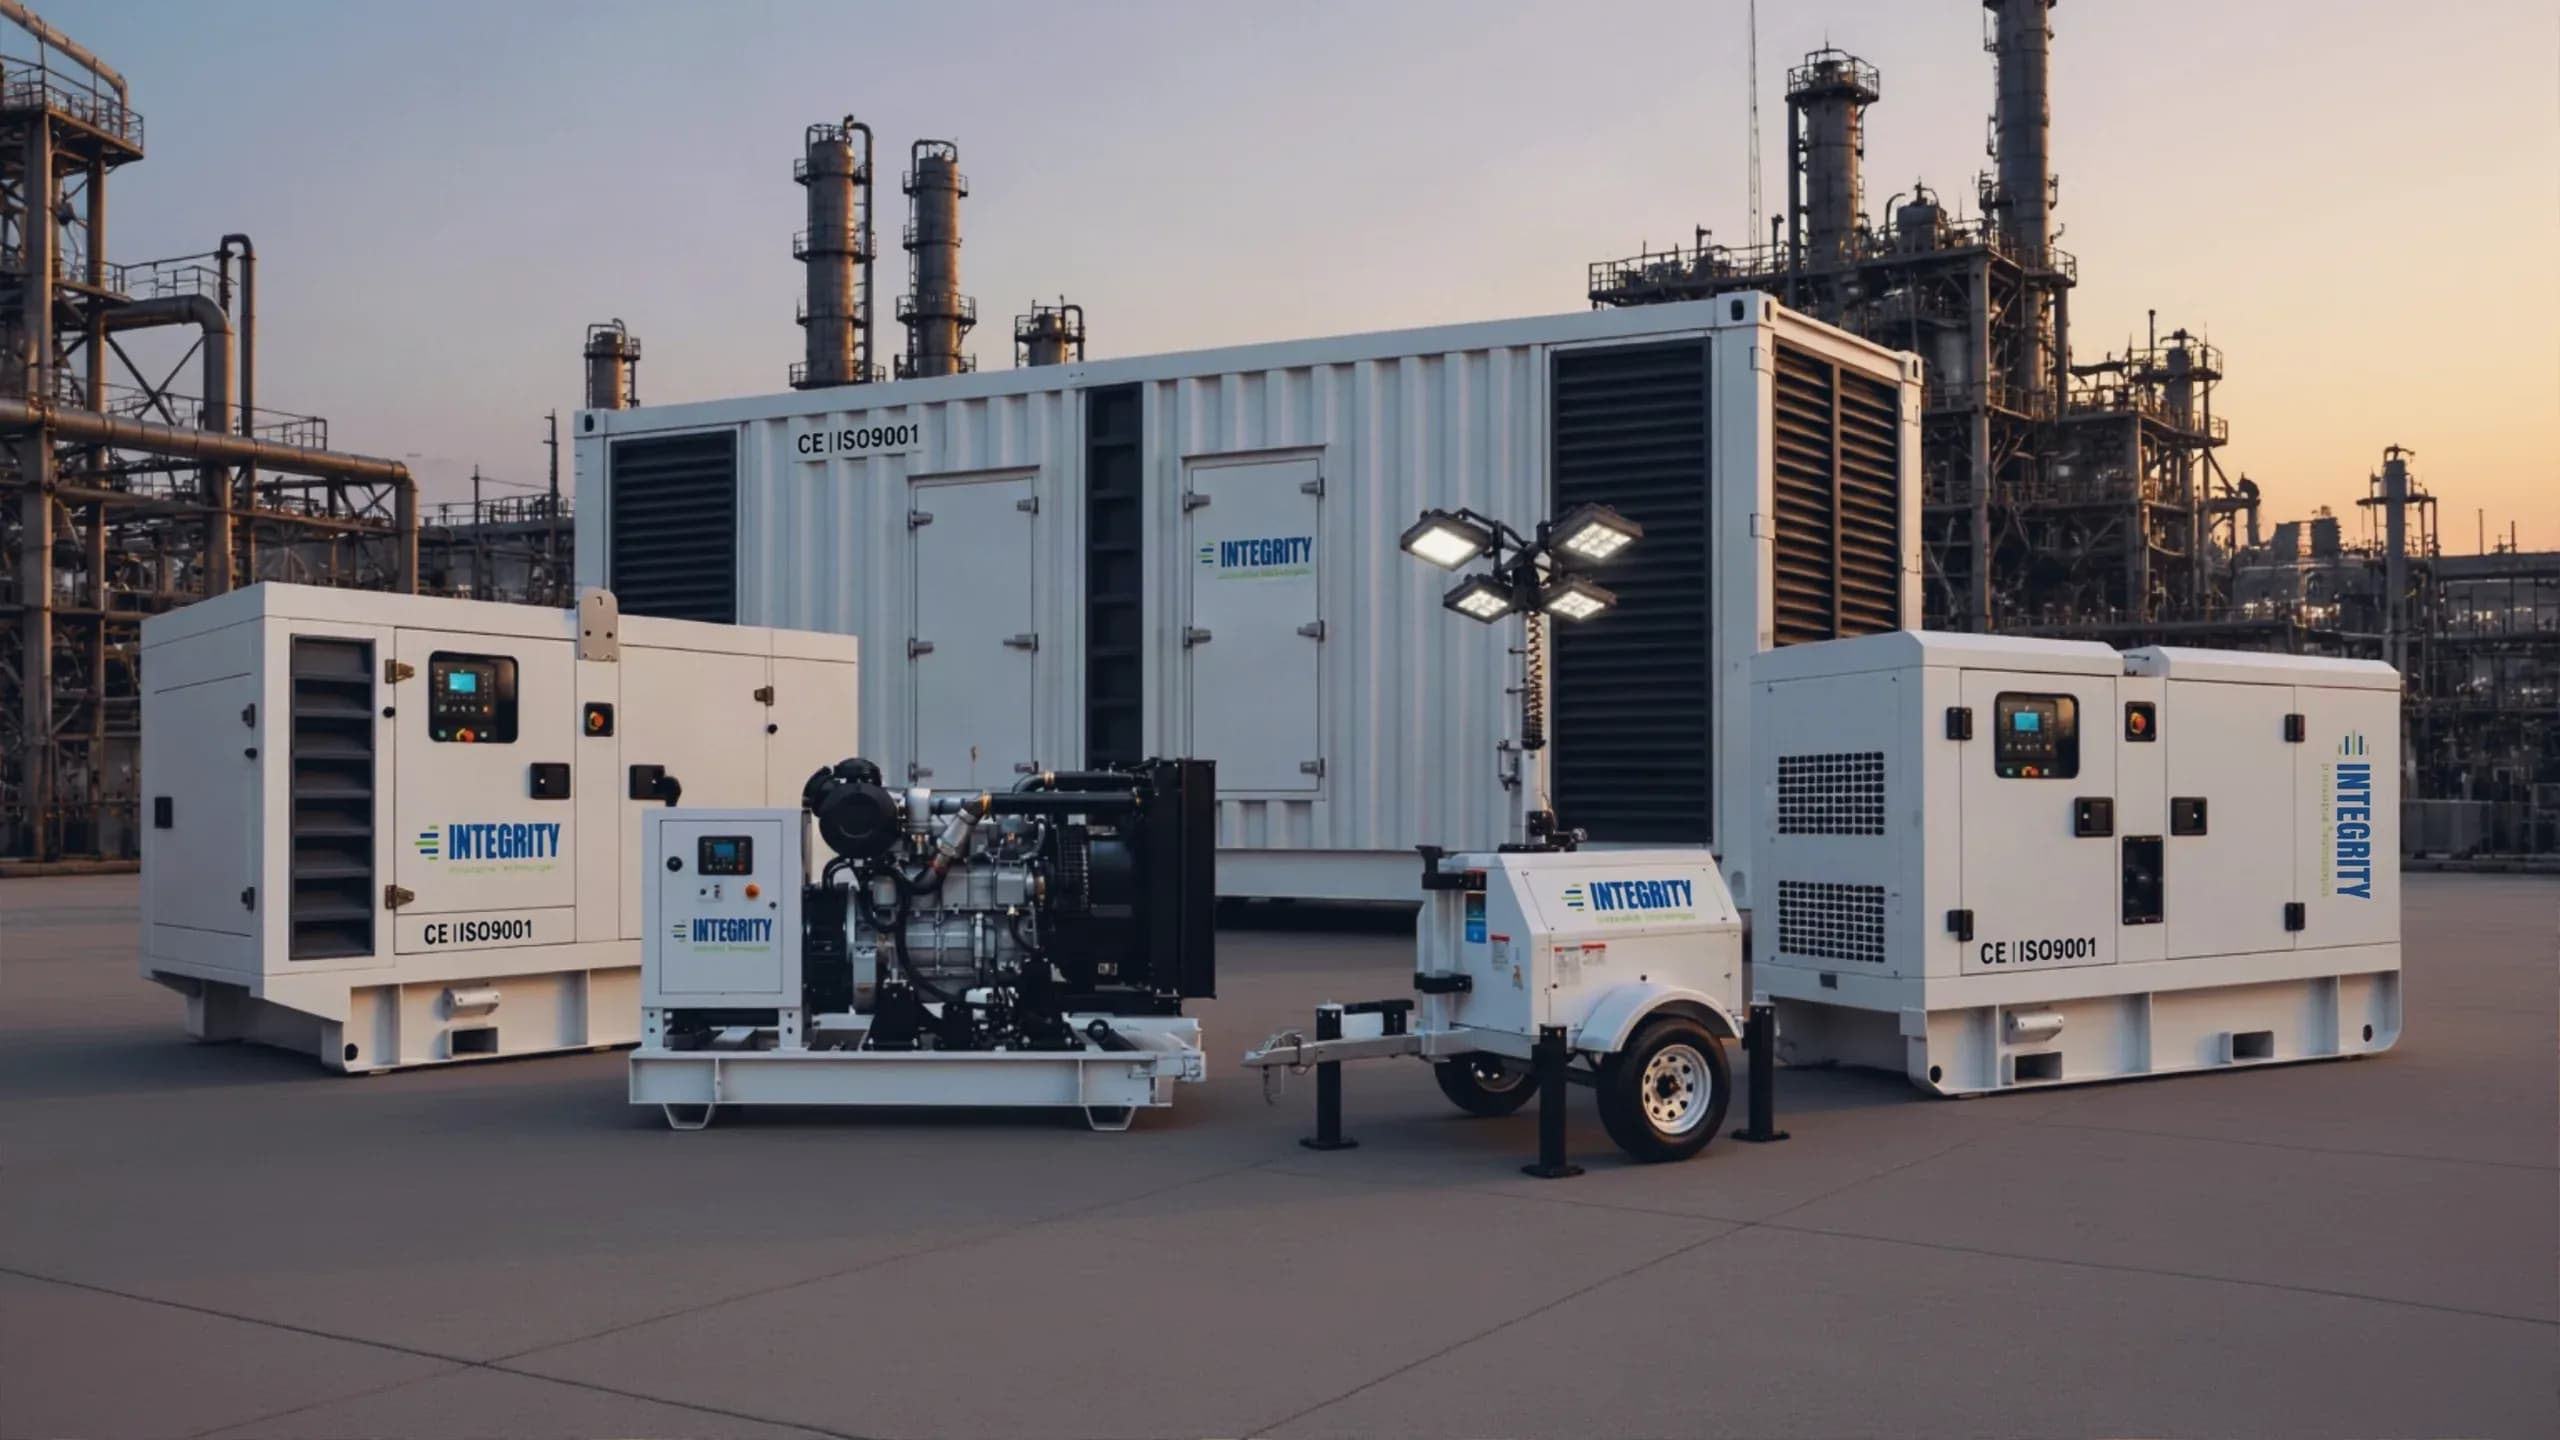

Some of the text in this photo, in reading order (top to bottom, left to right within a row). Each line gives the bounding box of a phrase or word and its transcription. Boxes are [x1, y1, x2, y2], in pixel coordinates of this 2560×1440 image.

[798, 434, 824, 454] CE
[837, 424, 918, 451] ISO9001
[1220, 536, 1313, 568] INTEGRITY
[448, 822, 561, 860] INTEGRITY
[2336, 763, 2371, 900] INTEGRITY
[1589, 879, 1692, 911] INTEGRITY
[424, 923, 449, 945] CE
[459, 919, 532, 943] ISO9001
[692, 917, 773, 942] INTEGRITY
[1980, 942, 2007, 965] CE
[2019, 936, 2096, 962] ISO9001
